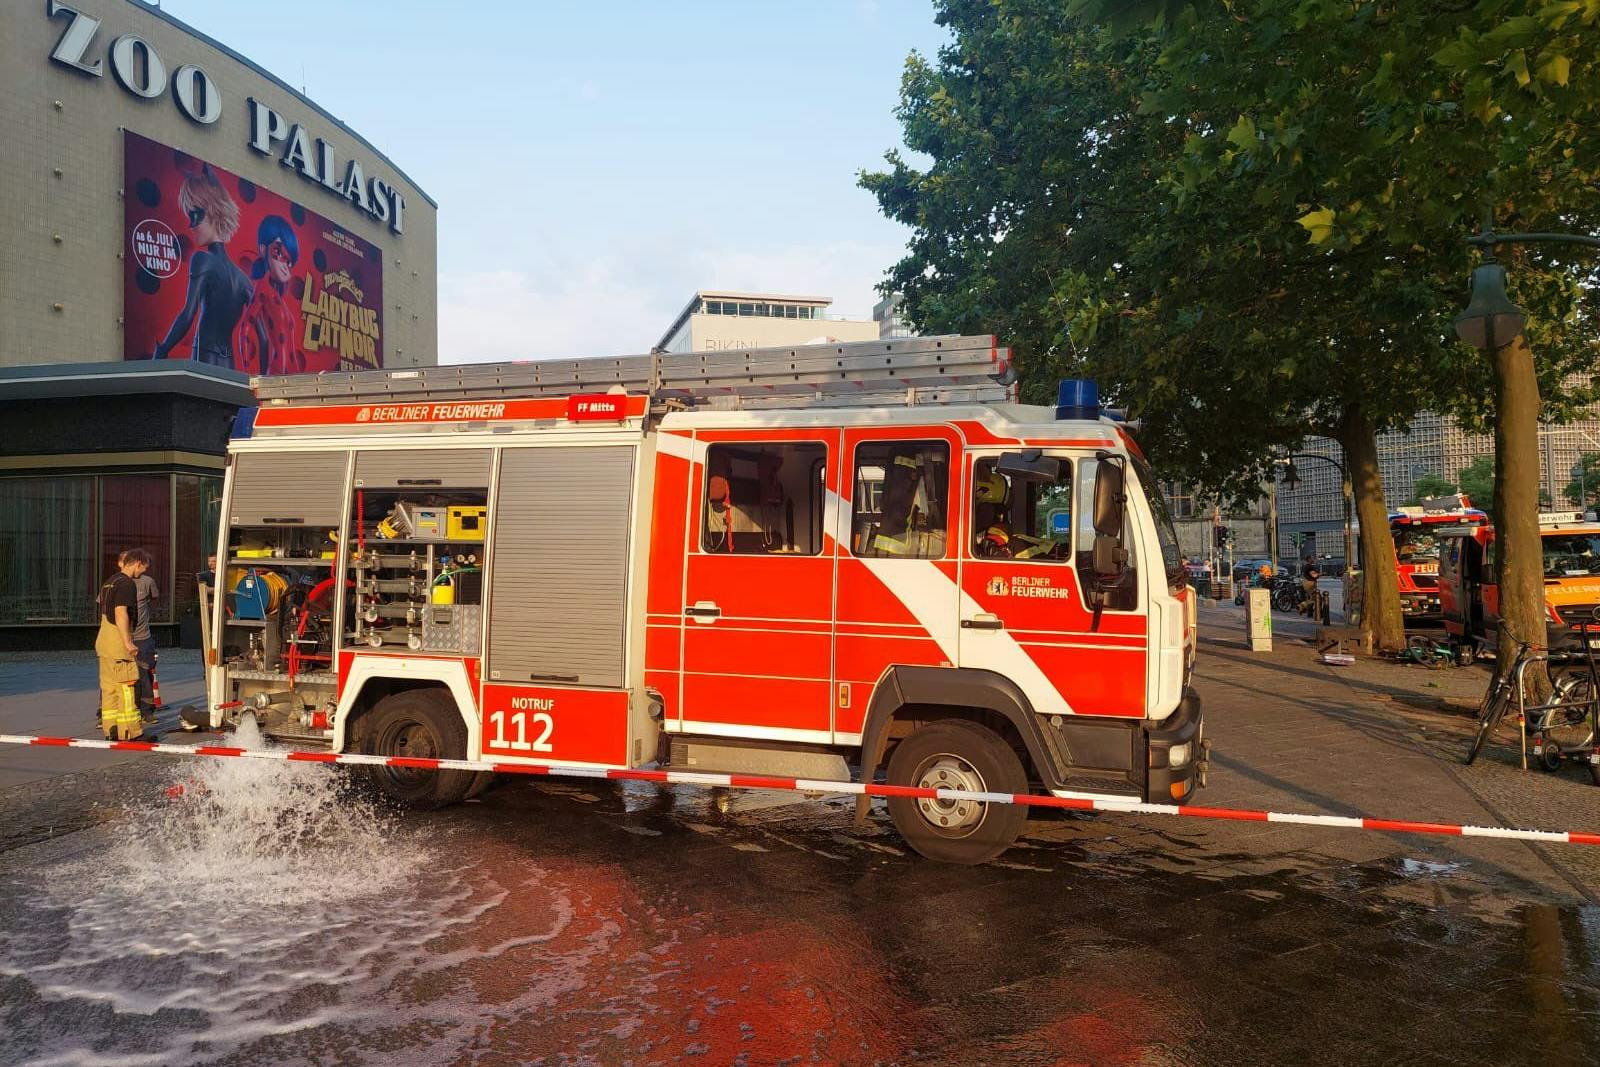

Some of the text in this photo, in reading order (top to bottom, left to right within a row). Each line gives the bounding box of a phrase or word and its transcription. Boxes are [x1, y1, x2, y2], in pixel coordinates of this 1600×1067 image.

[47, 1, 406, 234] ZOO PALAST
[146, 230, 155, 243] 6.
[156, 232, 173, 247] JULI
[138, 242, 176, 260] NUR IM
[146, 256, 171, 271] KINO
[301, 271, 379, 340] LADYBUG
[705, 339, 758, 351] BIKINI
[372, 403, 505, 420] BERLINER FEUERWEHR
[577, 402, 615, 412] FF Mitte
[1011, 576, 1051, 586] BERLINER
[1011, 586, 1068, 599] FEUERWEHR
[511, 697, 555, 710] NOTRUF
[489, 710, 554, 752] 112
